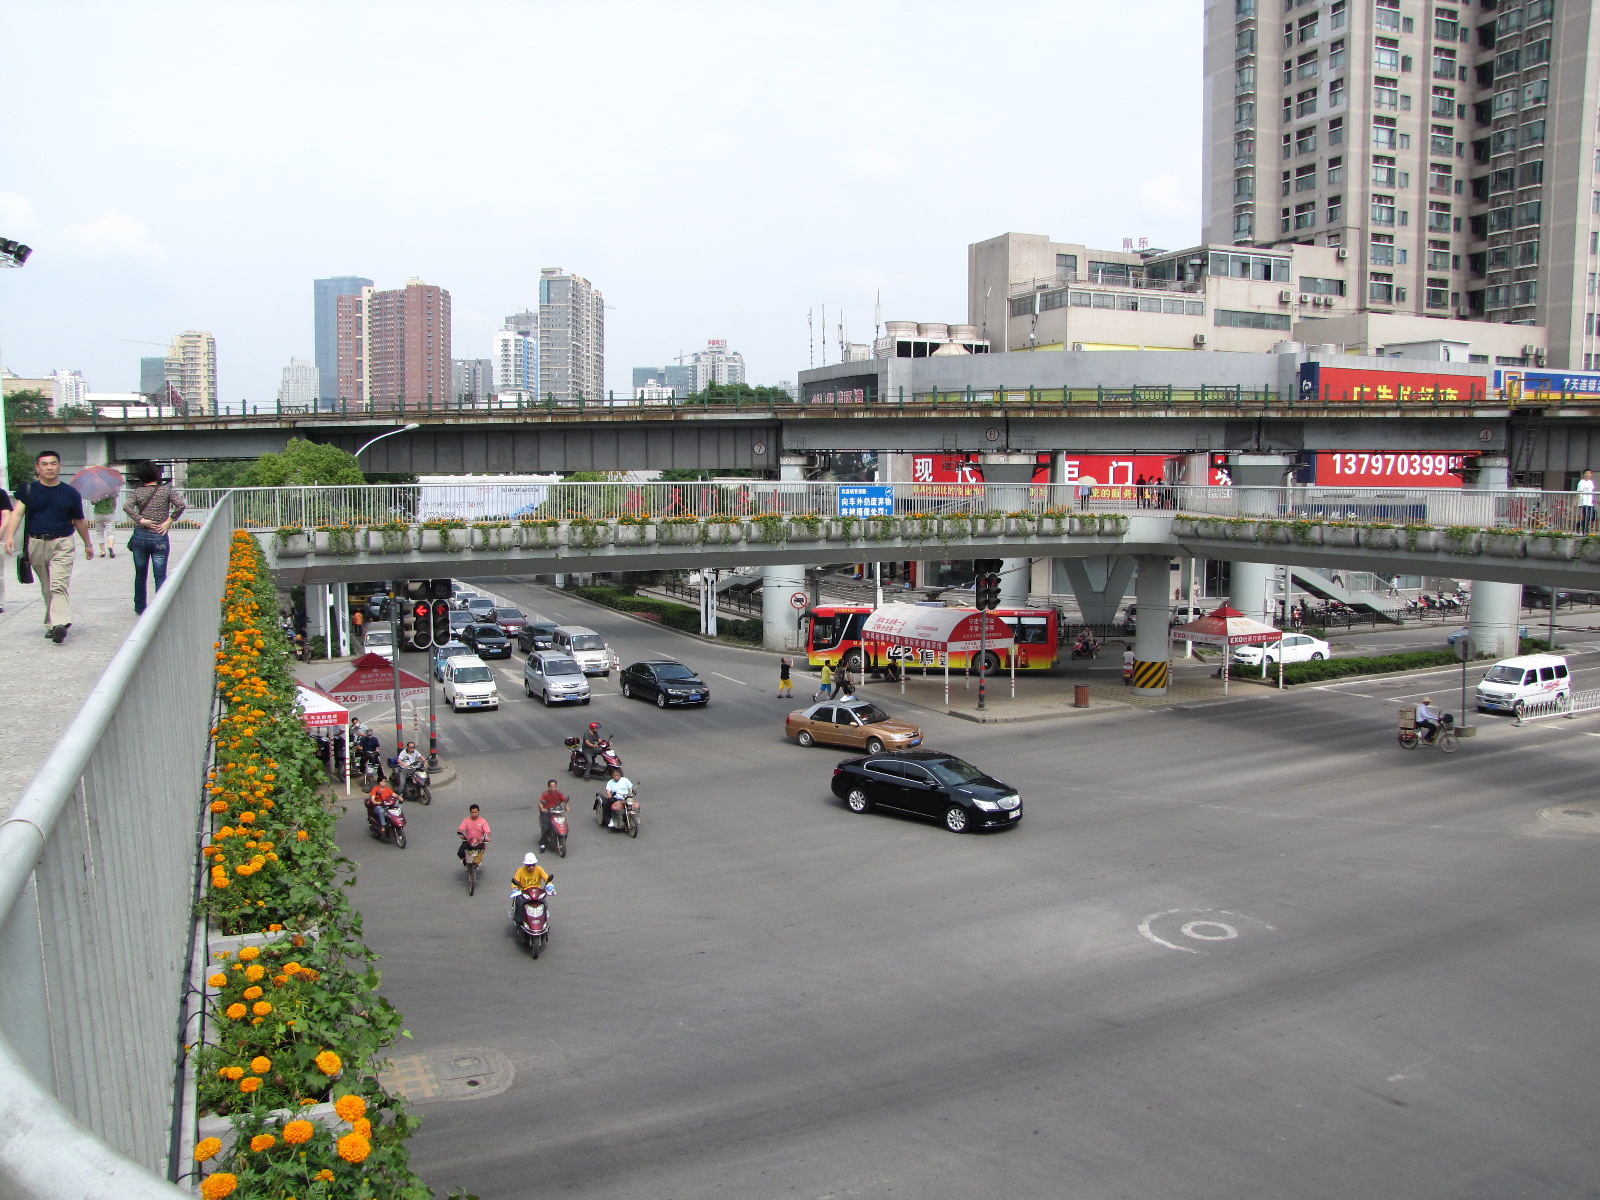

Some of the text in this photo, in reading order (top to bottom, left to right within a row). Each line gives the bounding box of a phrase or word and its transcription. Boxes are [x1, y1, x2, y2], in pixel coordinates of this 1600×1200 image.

[1123, 238, 1148, 248] 凯乐
[841, 497, 892, 506] 向车外扔废弃物
